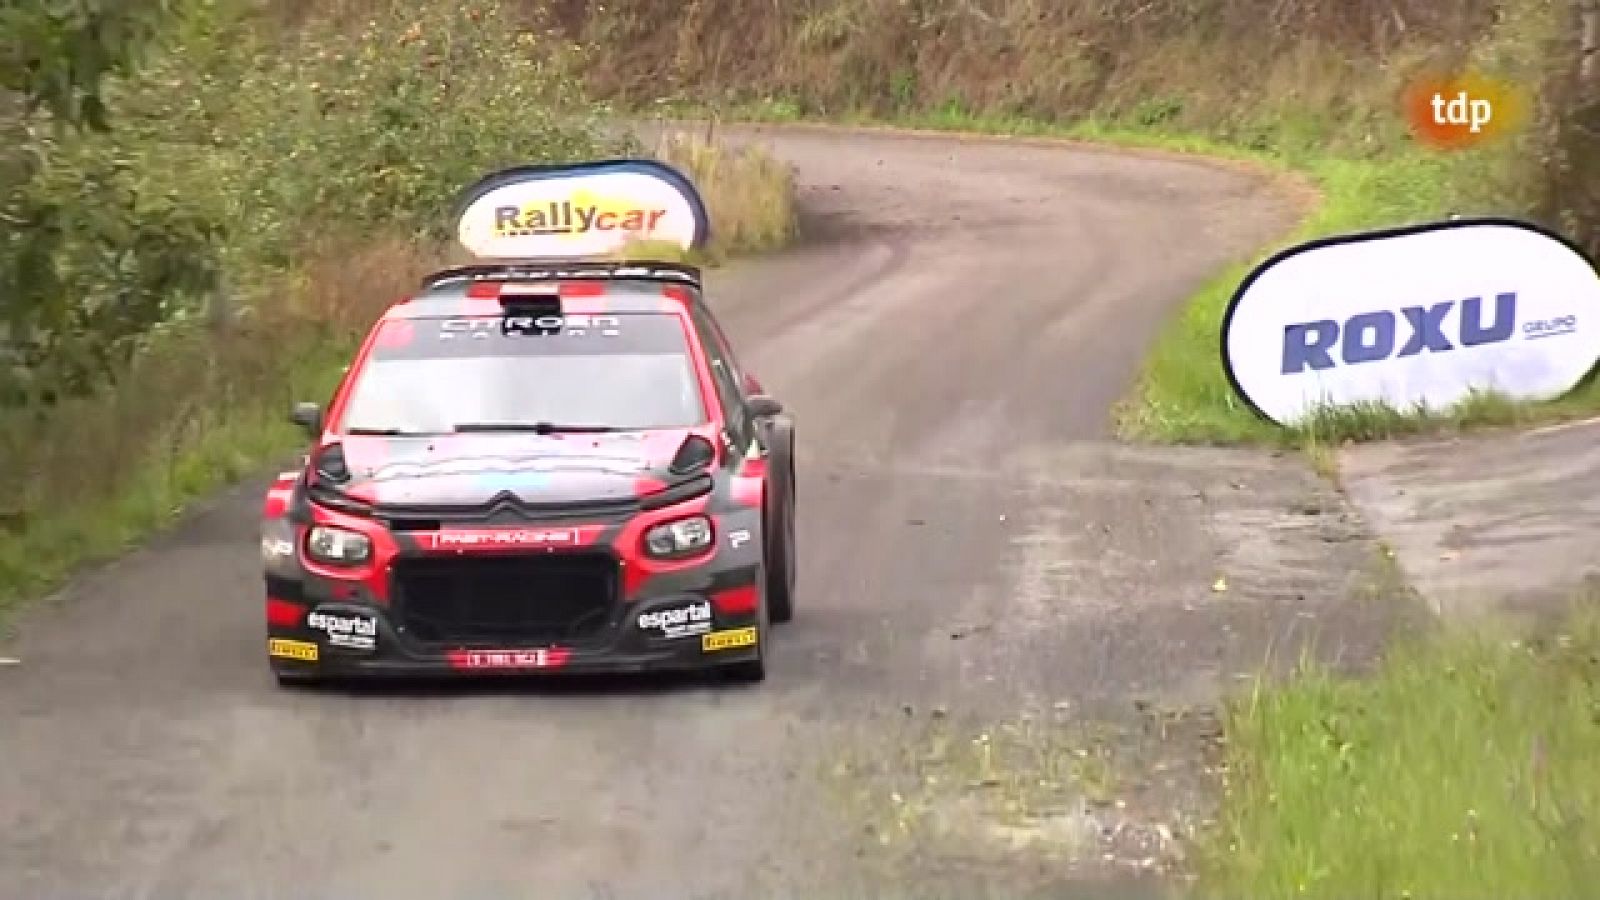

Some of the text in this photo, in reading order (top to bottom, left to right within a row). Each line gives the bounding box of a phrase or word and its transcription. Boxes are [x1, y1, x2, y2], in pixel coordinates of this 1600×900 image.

[494, 199, 667, 234] Rallycar
[1280, 291, 1517, 376] ROXU
[307, 611, 376, 636] espartal
[639, 601, 711, 631] espartal
